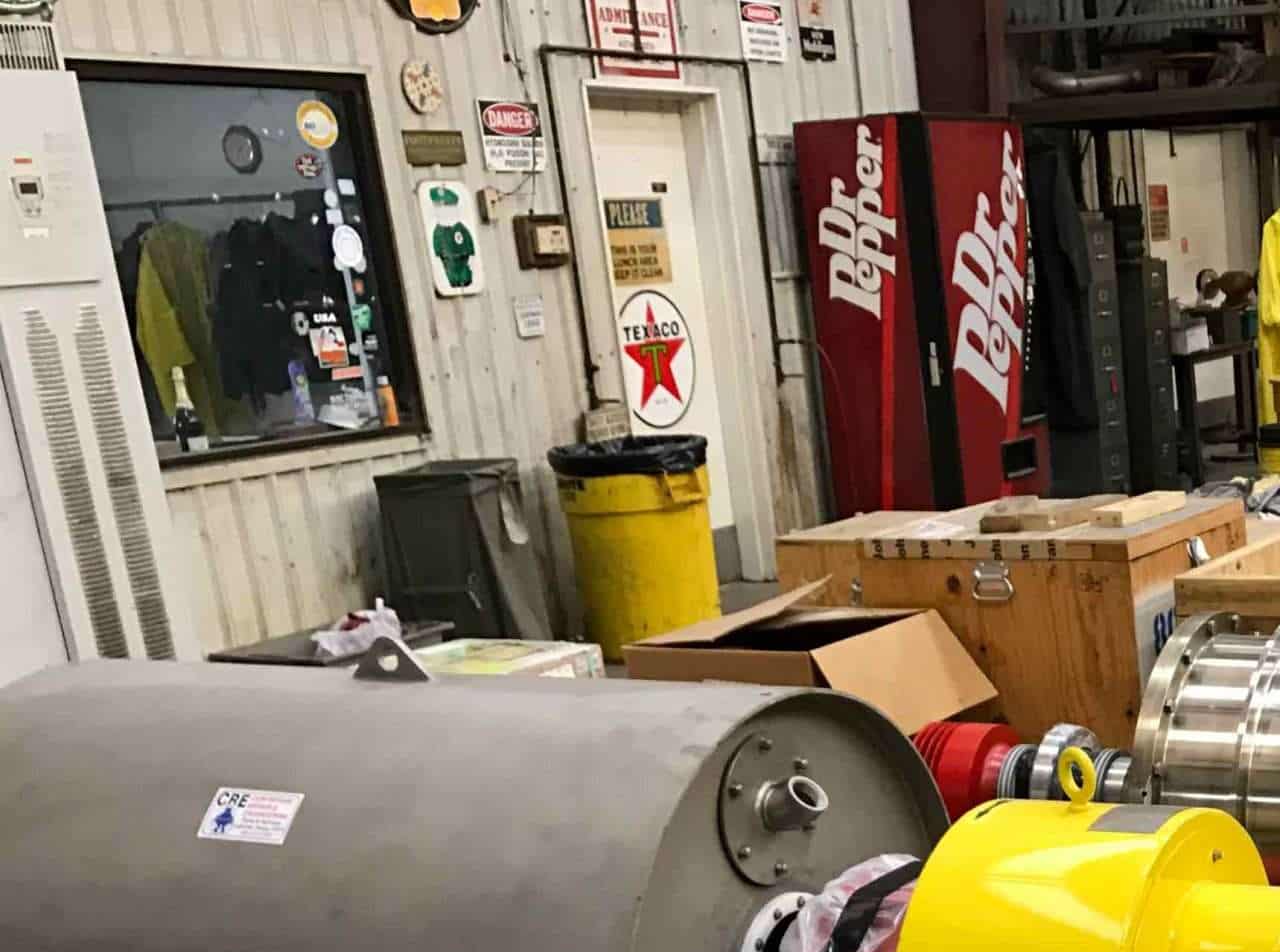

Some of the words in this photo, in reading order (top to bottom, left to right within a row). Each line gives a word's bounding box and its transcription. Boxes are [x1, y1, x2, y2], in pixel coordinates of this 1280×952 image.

[487, 109, 534, 129] DANGER
[607, 202, 648, 226] PLEASE
[818, 176, 857, 252] Dr
[829, 123, 897, 321] Pepper
[952, 191, 999, 296] Dr
[953, 130, 1025, 416] Pepper
[313, 312, 336, 323] USA
[623, 321, 680, 342] TEXACO
[217, 791, 250, 809] CRE
